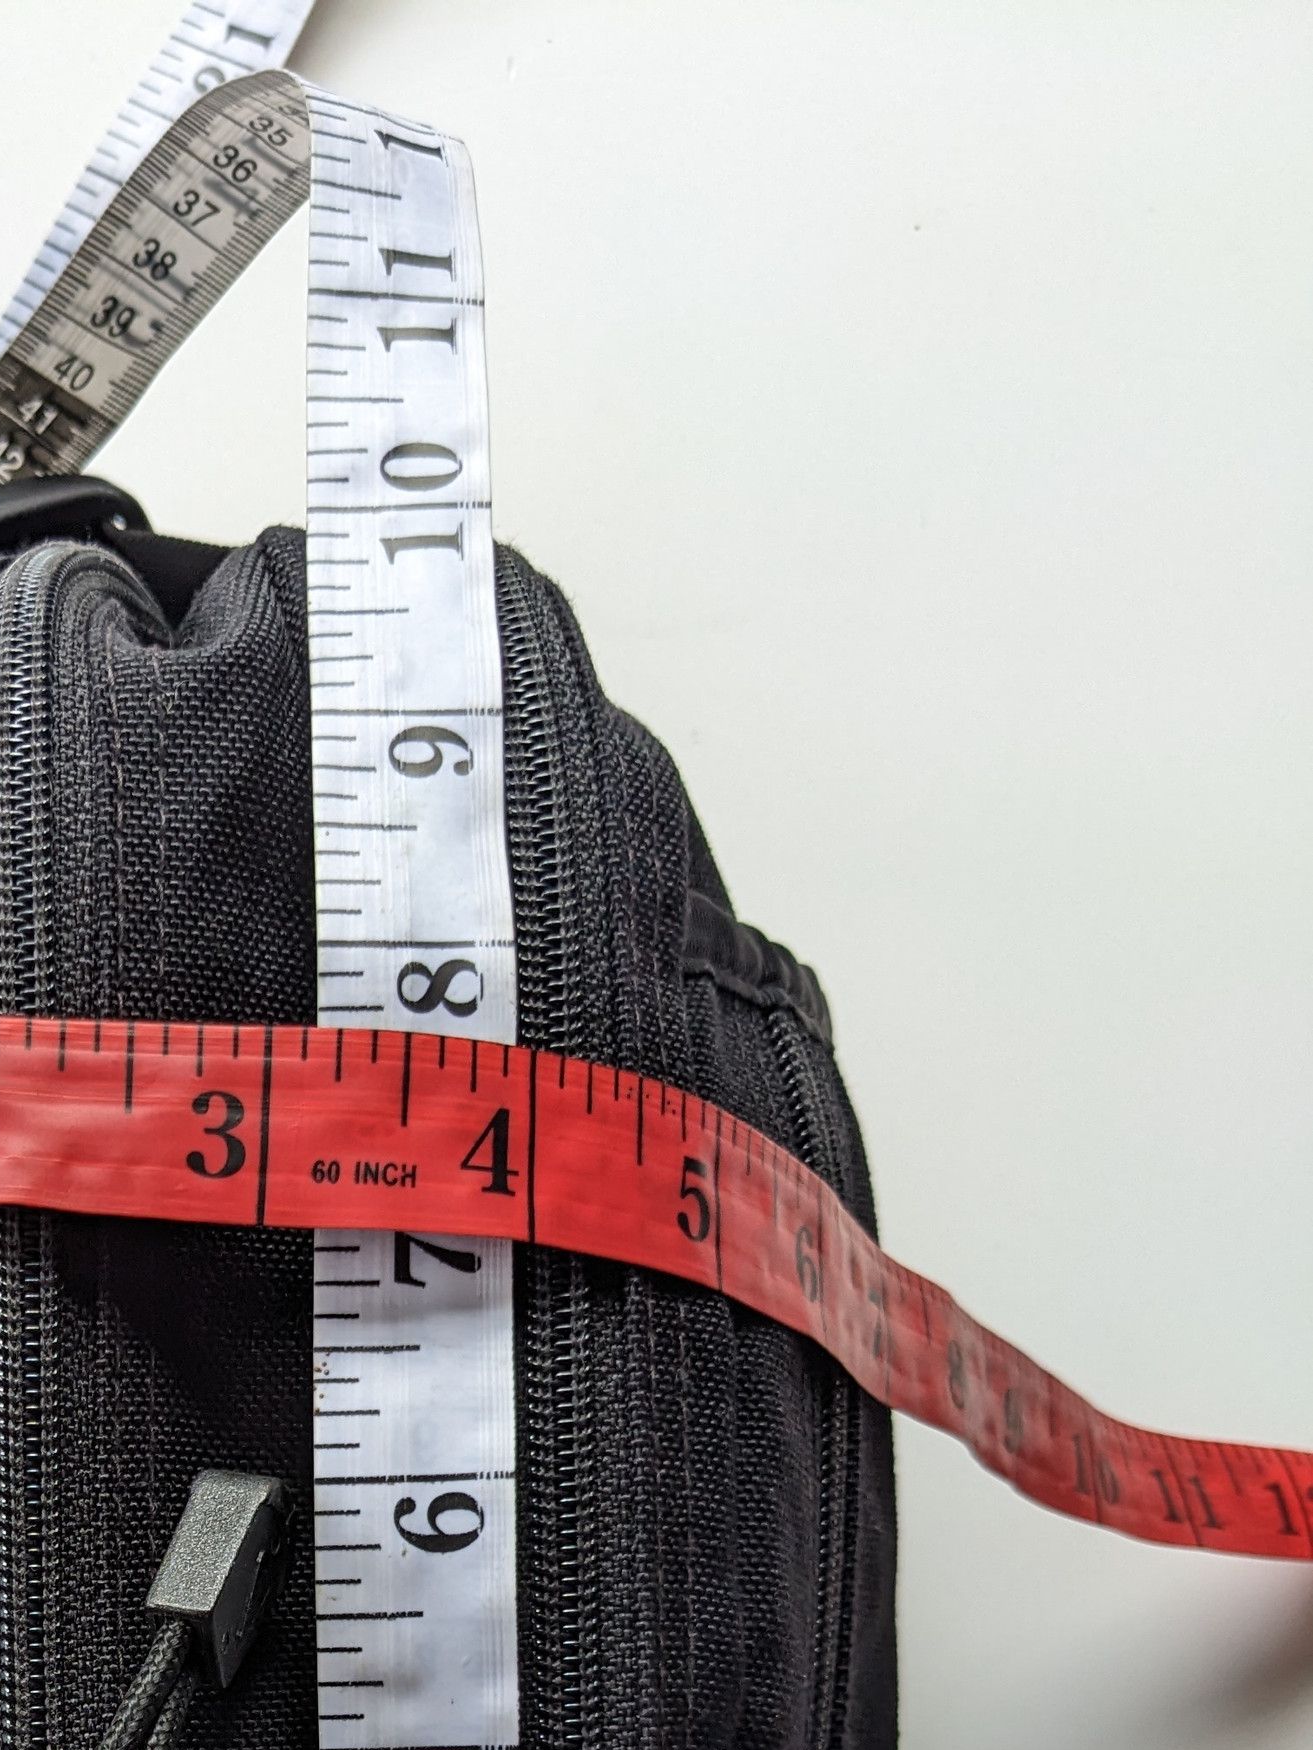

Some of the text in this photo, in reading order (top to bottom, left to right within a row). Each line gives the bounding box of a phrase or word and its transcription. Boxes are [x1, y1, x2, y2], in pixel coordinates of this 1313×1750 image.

[249, 115, 294, 147] 35
[213, 145, 258, 183] 36
[173, 190, 220, 227] 37
[132, 239, 177, 281] 38
[90, 296, 137, 338] 39
[376, 248, 458, 355] 11
[54, 356, 95, 391] 40
[17, 400, 59, 434] 41
[379, 442, 464, 565] 10
[388, 726, 474, 778] 9
[397, 958, 484, 1018] 8
[186, 1091, 246, 1178] 3
[461, 1108, 520, 1197] 4
[311, 1159, 418, 1189] 60 INCH
[676, 1157, 711, 1243] 5
[796, 1226, 820, 1303] 6
[947, 1340, 969, 1410] 8
[1073, 1434, 1121, 1506] 10
[1150, 1469, 1223, 1530] 11
[394, 1491, 485, 1555] 6
[1266, 1483, 1313, 1536] 1
